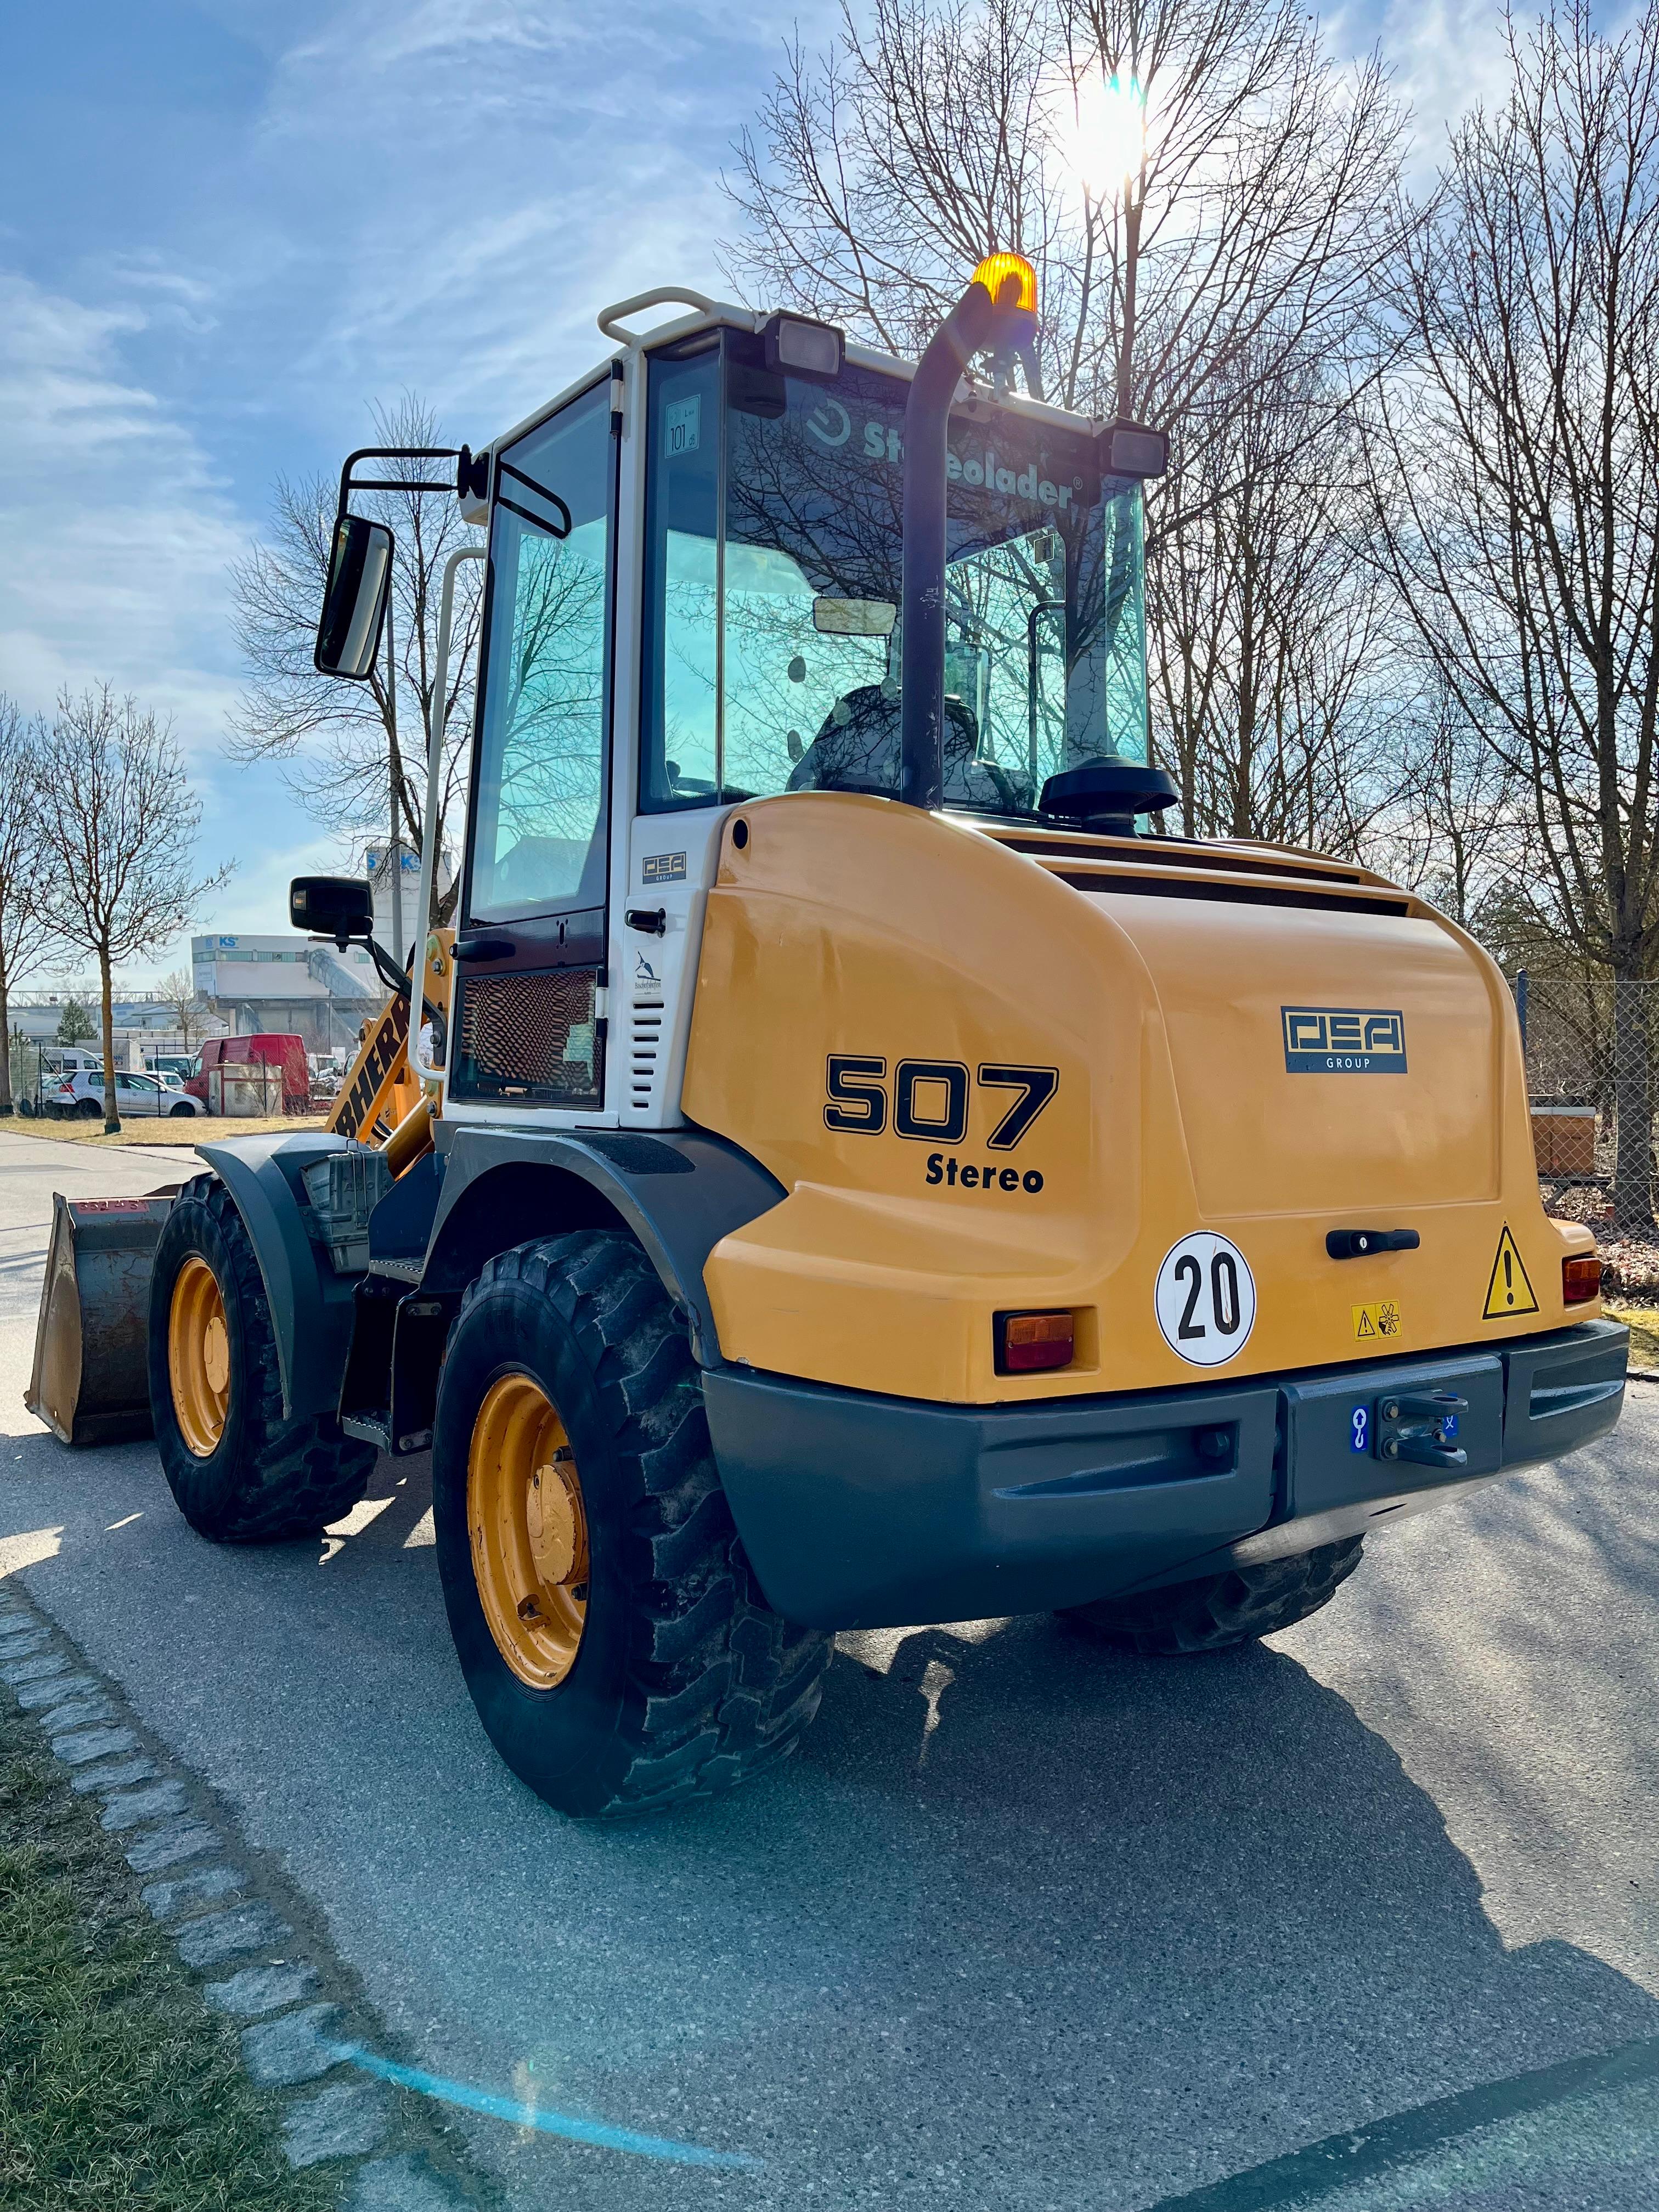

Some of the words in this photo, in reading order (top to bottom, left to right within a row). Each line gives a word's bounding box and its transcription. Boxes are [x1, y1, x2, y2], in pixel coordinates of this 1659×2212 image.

[670, 423, 685, 452] 101
[331, 993, 412, 1138] BHERR
[1326, 1057, 1370, 1069] GROUP
[823, 1053, 1059, 1152] 507
[925, 1153, 1044, 1194] Stereo
[1175, 1251, 1240, 1340] 20
